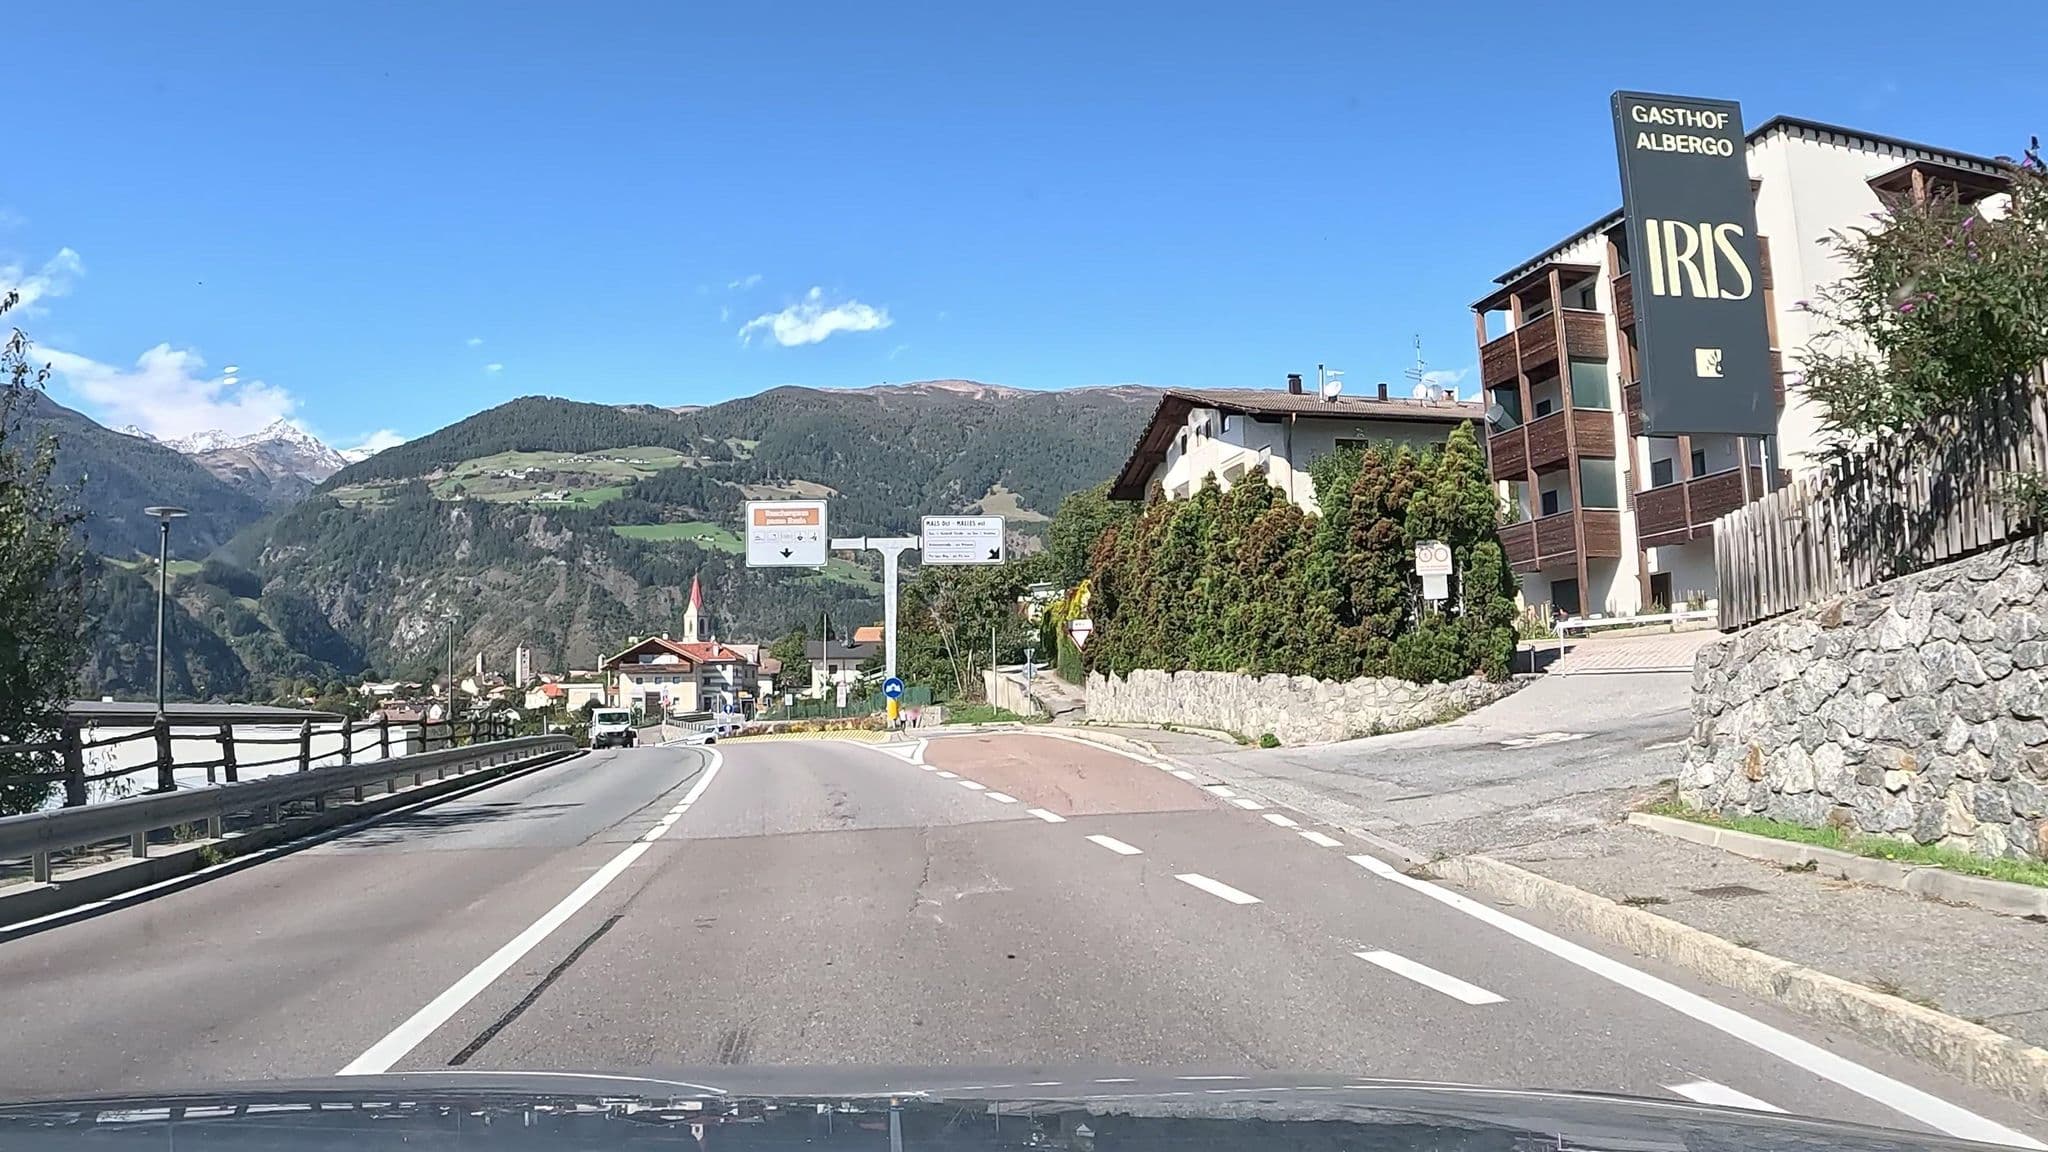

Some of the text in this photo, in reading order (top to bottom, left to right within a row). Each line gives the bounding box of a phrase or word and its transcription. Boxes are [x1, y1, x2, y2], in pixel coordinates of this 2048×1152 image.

[1631, 104, 1729, 130] GASTHOF
[1635, 132, 1734, 157] ALBERGO
[1645, 218, 1753, 301] IRIS
